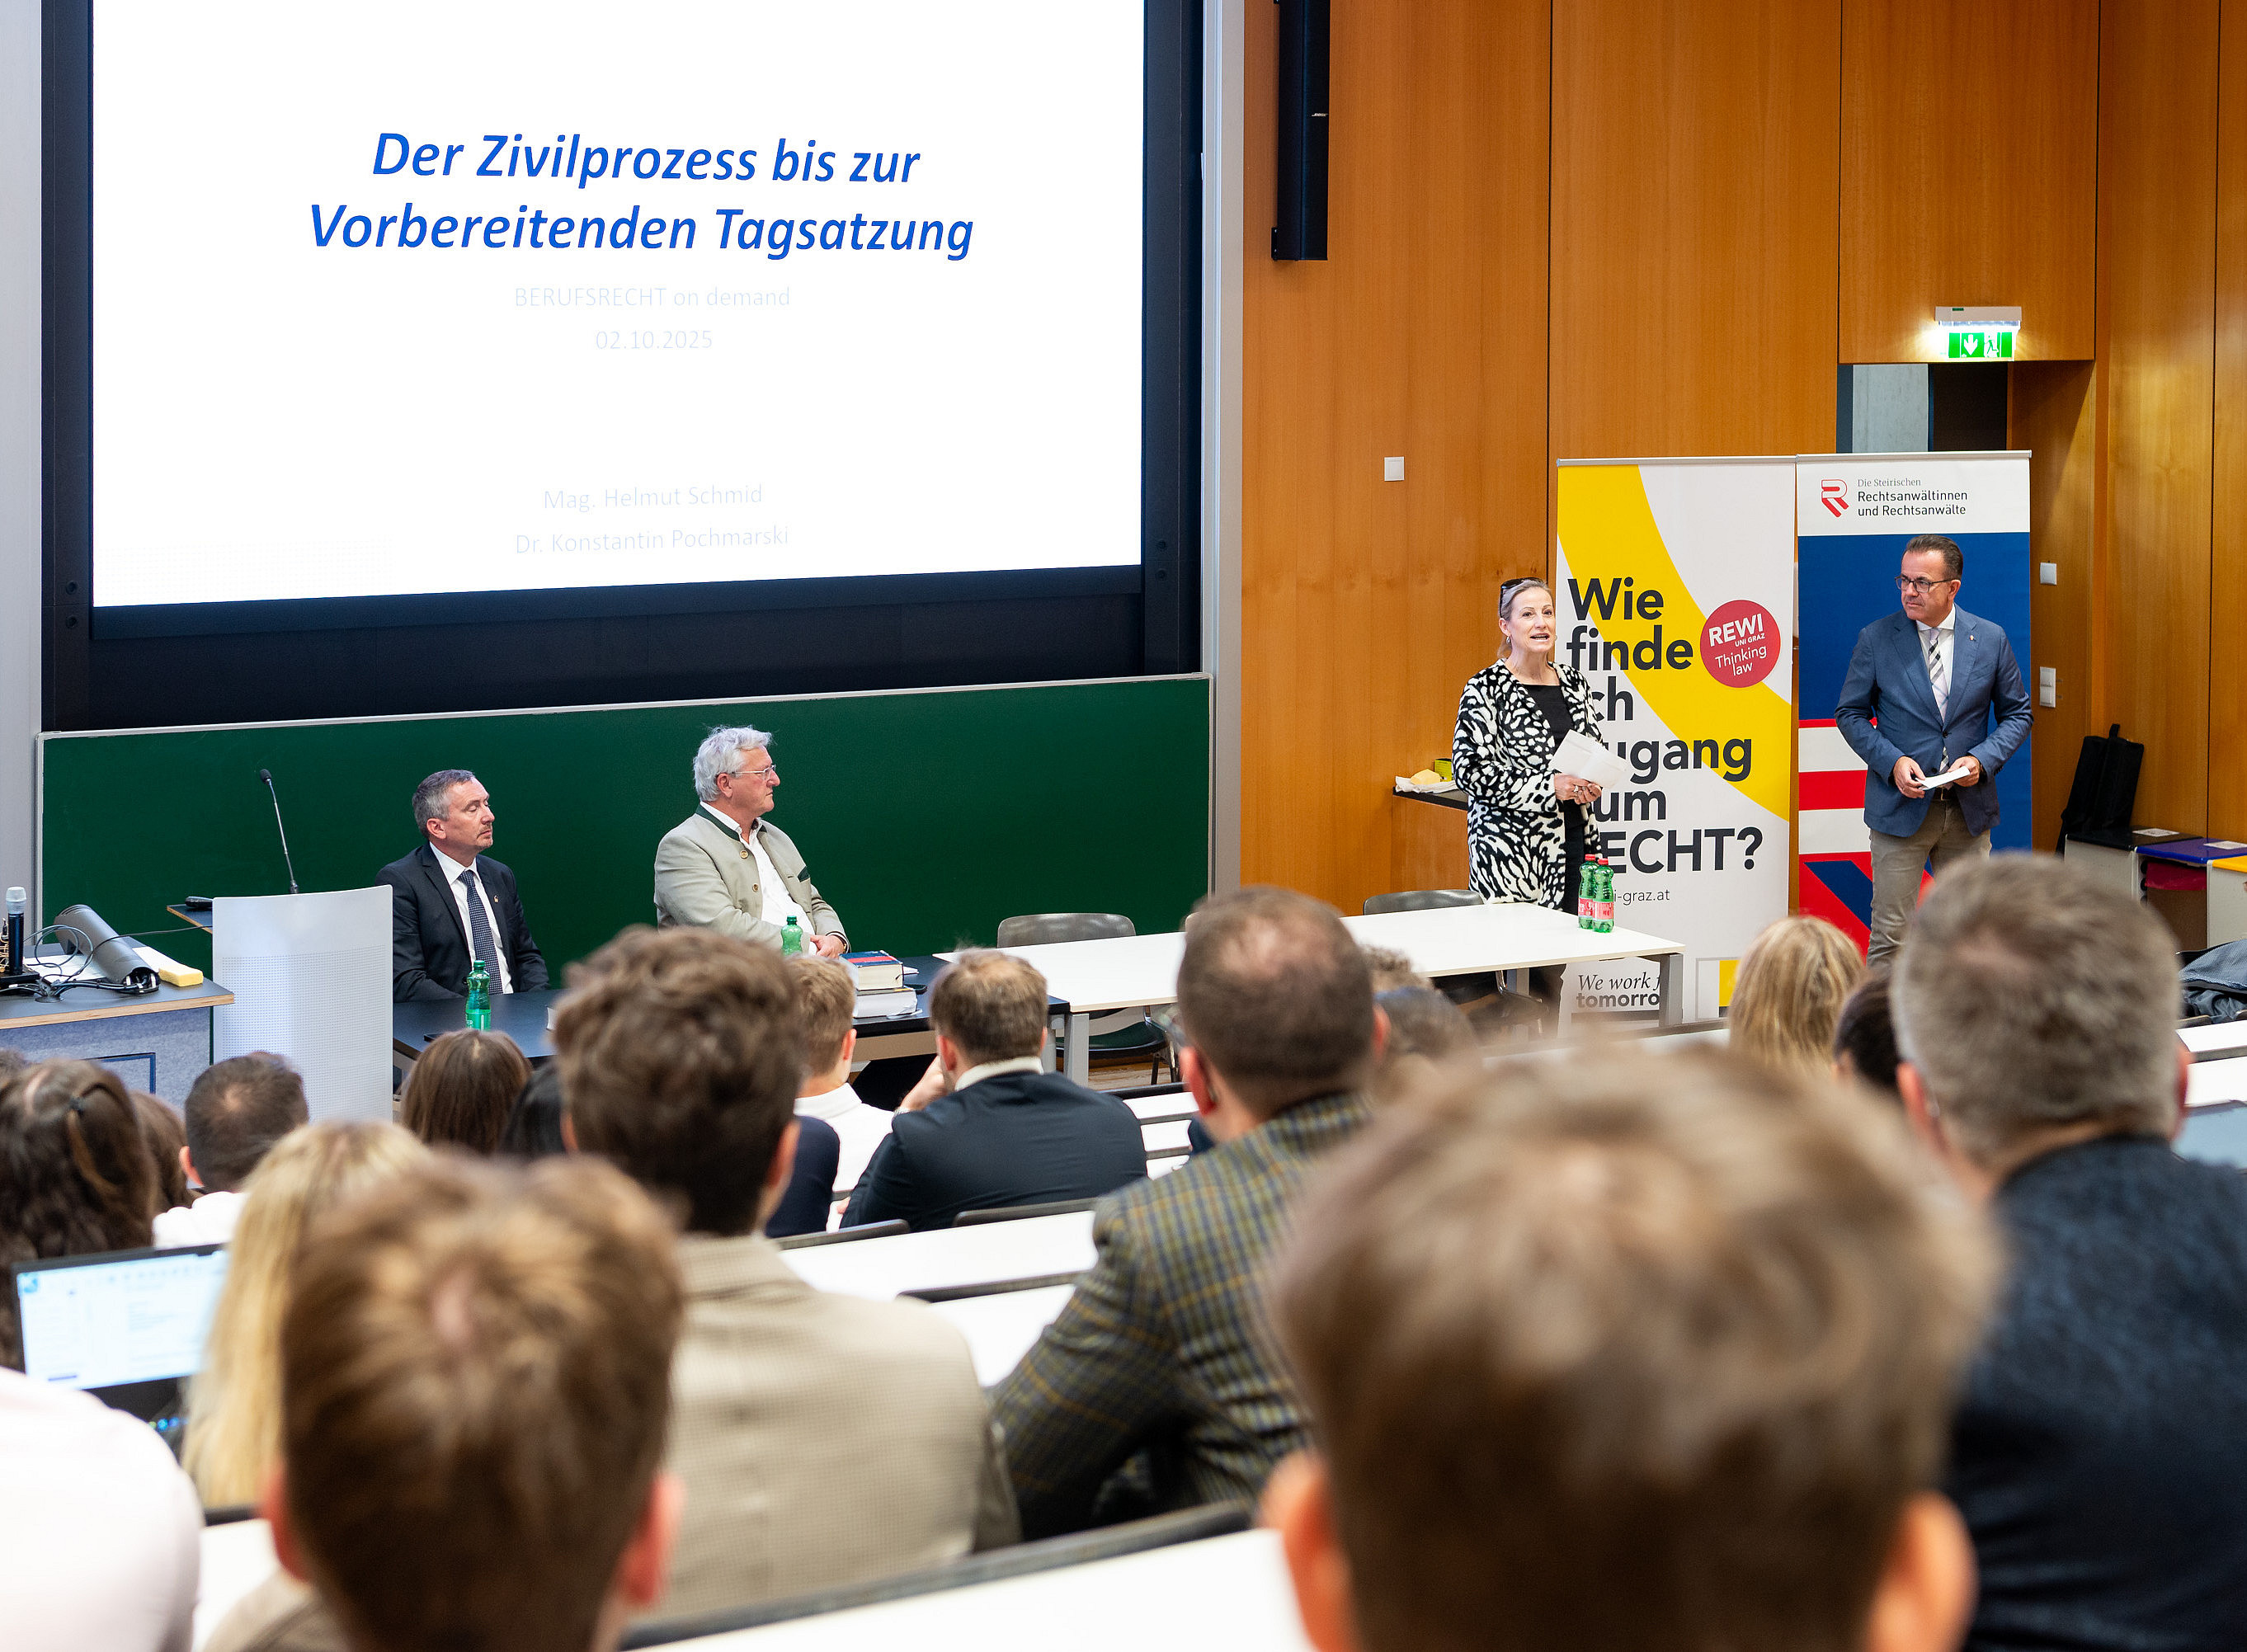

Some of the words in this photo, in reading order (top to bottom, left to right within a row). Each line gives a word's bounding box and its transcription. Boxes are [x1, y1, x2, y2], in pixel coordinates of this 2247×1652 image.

[373, 133, 464, 176] Der
[477, 134, 756, 189] Zivilprozess
[772, 139, 836, 181] bis
[850, 152, 921, 183] zur
[311, 203, 695, 249] Vorbereitenden
[716, 209, 973, 261] Tagsatzung
[514, 287, 667, 308] BERUFSRECHT
[673, 292, 699, 307] on
[706, 286, 790, 308] demand
[594, 330, 714, 351] 02.10.2025
[1858, 478, 1872, 487] Die
[1873, 478, 1921, 487] Steirischen
[1858, 490, 1967, 502] Rechtsanwältinnen
[542, 488, 596, 513] Mag.
[605, 487, 681, 509] Helmut
[688, 483, 765, 506] Schmid
[1858, 506, 1879, 516] und
[1882, 504, 1967, 516] Rechtsanwälte
[516, 534, 543, 555] Dr.
[550, 530, 665, 553] Konstantin
[672, 525, 789, 549] Pochmarski
[1567, 577, 1664, 620] Wie
[1708, 613, 1764, 647] REWI
[1735, 639, 1747, 647] UNI
[1747, 633, 1765, 643] GRAZ
[1566, 624, 1693, 671] finde
[1715, 645, 1767, 668] Thinking
[1733, 662, 1753, 676] law
[1590, 675, 1634, 722] ch
[1605, 738, 1752, 784] gang
[1593, 790, 1666, 822] um
[1599, 827, 1764, 874] ECHT?
[1578, 974, 1604, 991] We
[1609, 972, 1651, 990] work
[1576, 993, 1661, 1008] tomorro
